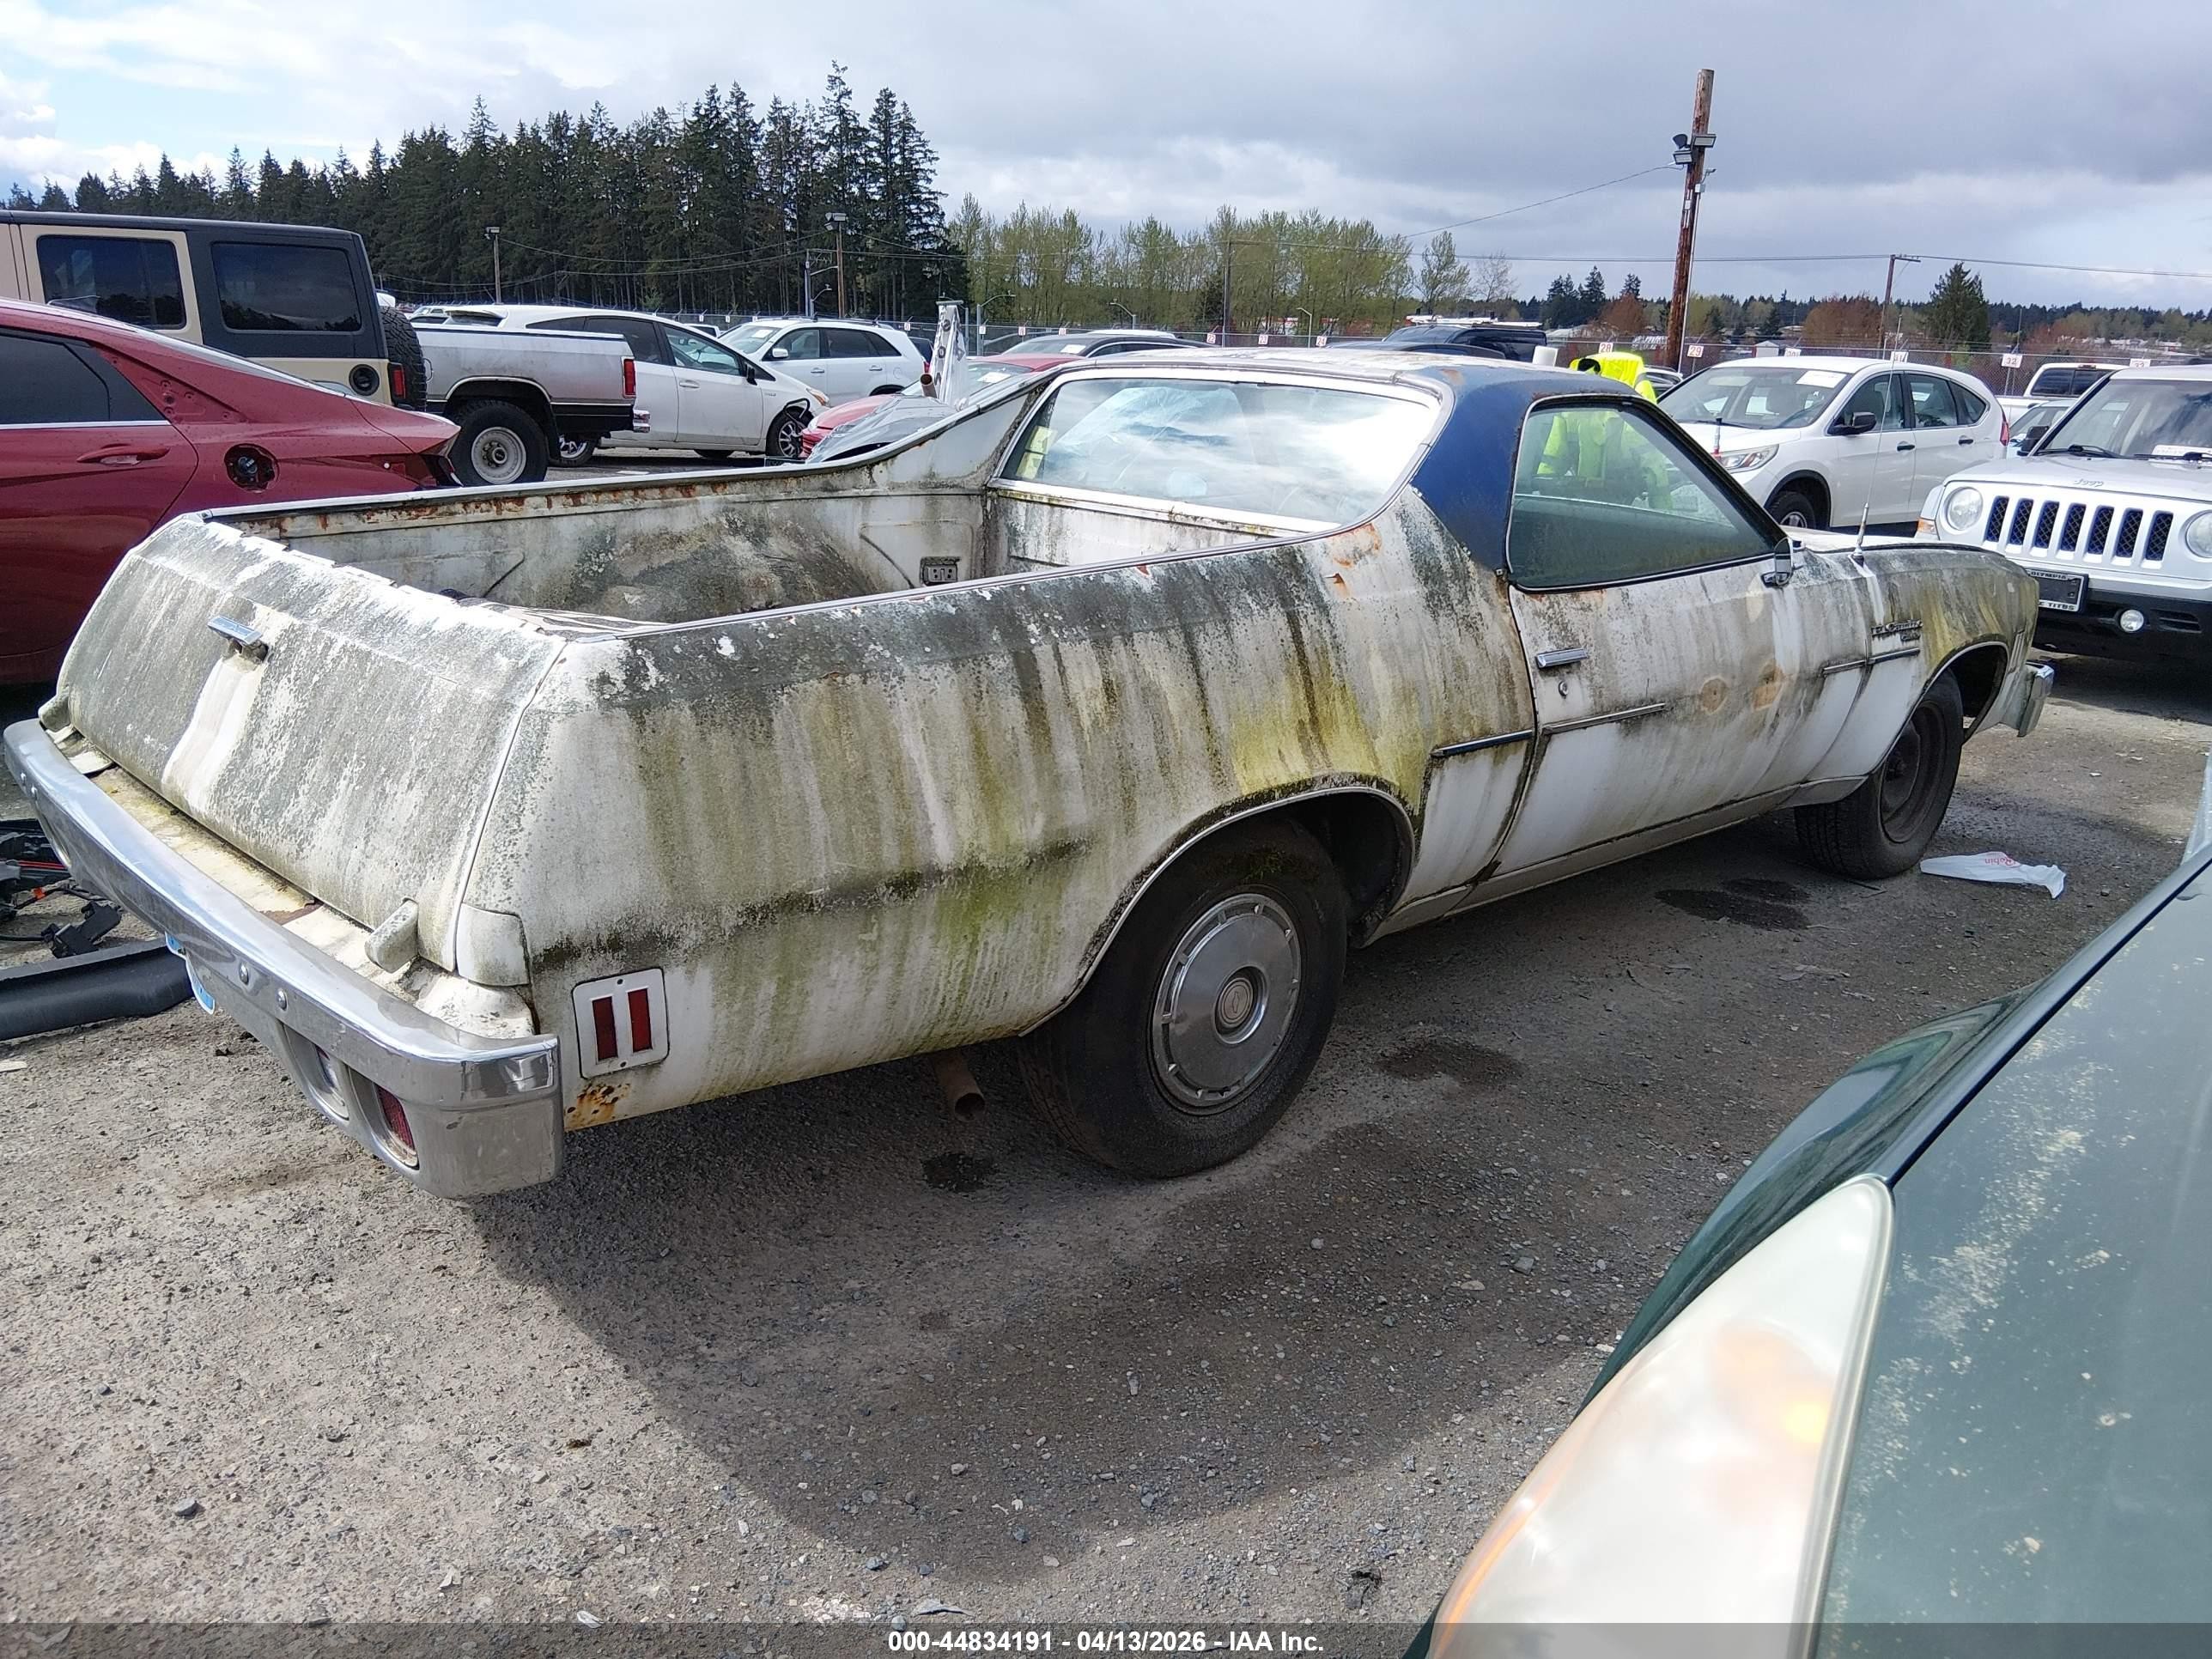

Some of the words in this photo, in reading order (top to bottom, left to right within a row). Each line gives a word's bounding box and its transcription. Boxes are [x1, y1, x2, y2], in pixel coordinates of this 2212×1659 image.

[1601, 342, 1612, 352] 28
[1689, 346, 1702, 356] 29
[2074, 478, 2104, 488] Jeep
[2031, 571, 2067, 580] OLYMPIA
[1984, 857, 2013, 866] Robin
